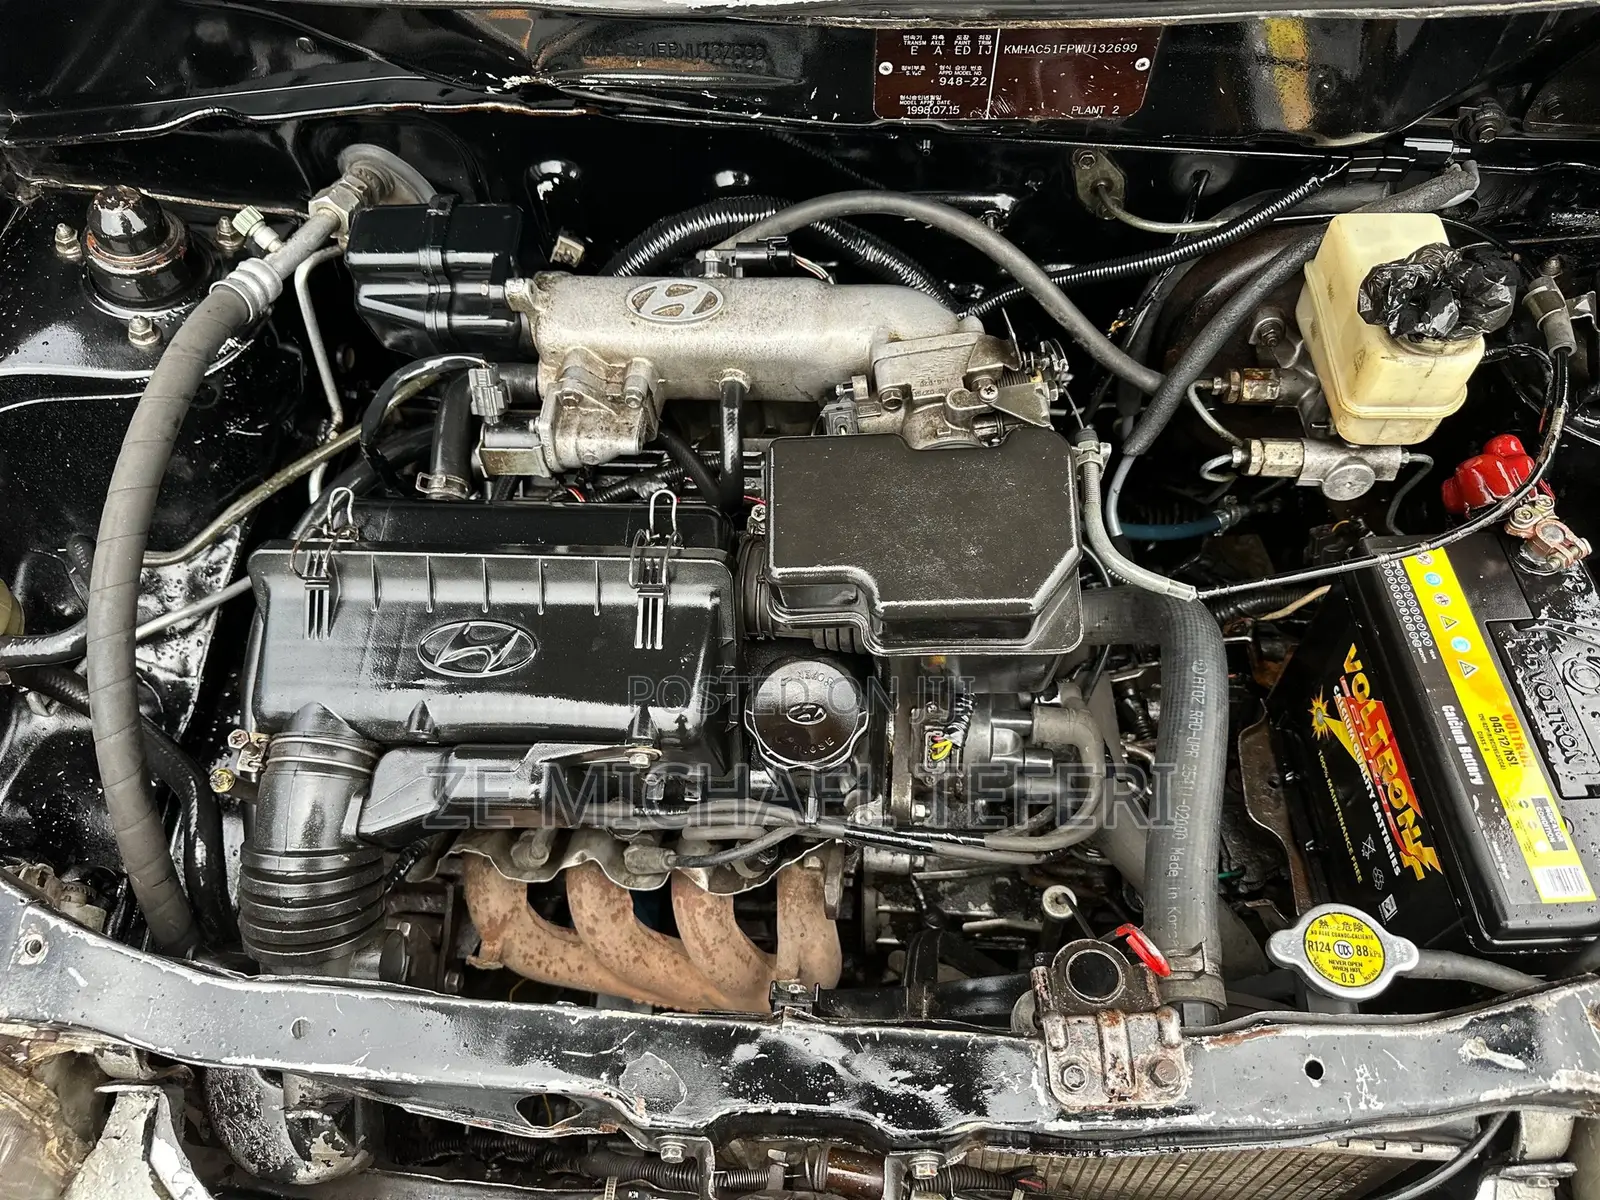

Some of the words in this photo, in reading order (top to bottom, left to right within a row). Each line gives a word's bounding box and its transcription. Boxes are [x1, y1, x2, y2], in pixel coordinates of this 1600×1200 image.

[910, 45, 919, 55] E
[932, 45, 943, 55] A
[954, 45, 972, 55] ED
[1003, 43, 1139, 55] KMHAC51FPWU132699
[939, 76, 988, 87] 948-22
[906, 105, 961, 115] 1998.07.15
[1070, 105, 1106, 115] PLANT
[1111, 105, 1120, 115] 2
[1191, 676, 1206, 706] ATOZ
[1441, 704, 1468, 745] Calcium
[1457, 746, 1485, 786] Battery
[1353, 741, 1376, 800] QUALITY
[1372, 800, 1401, 877] BATTERIES
[1326, 778, 1353, 856] MAINTENANCE
[1350, 855, 1364, 885] FREE
[1168, 847, 1185, 878] Made
[1167, 887, 1181, 900] in
[1308, 940, 1331, 954] R124
[1355, 945, 1369, 957] 88
[1340, 972, 1356, 984] 0.9
